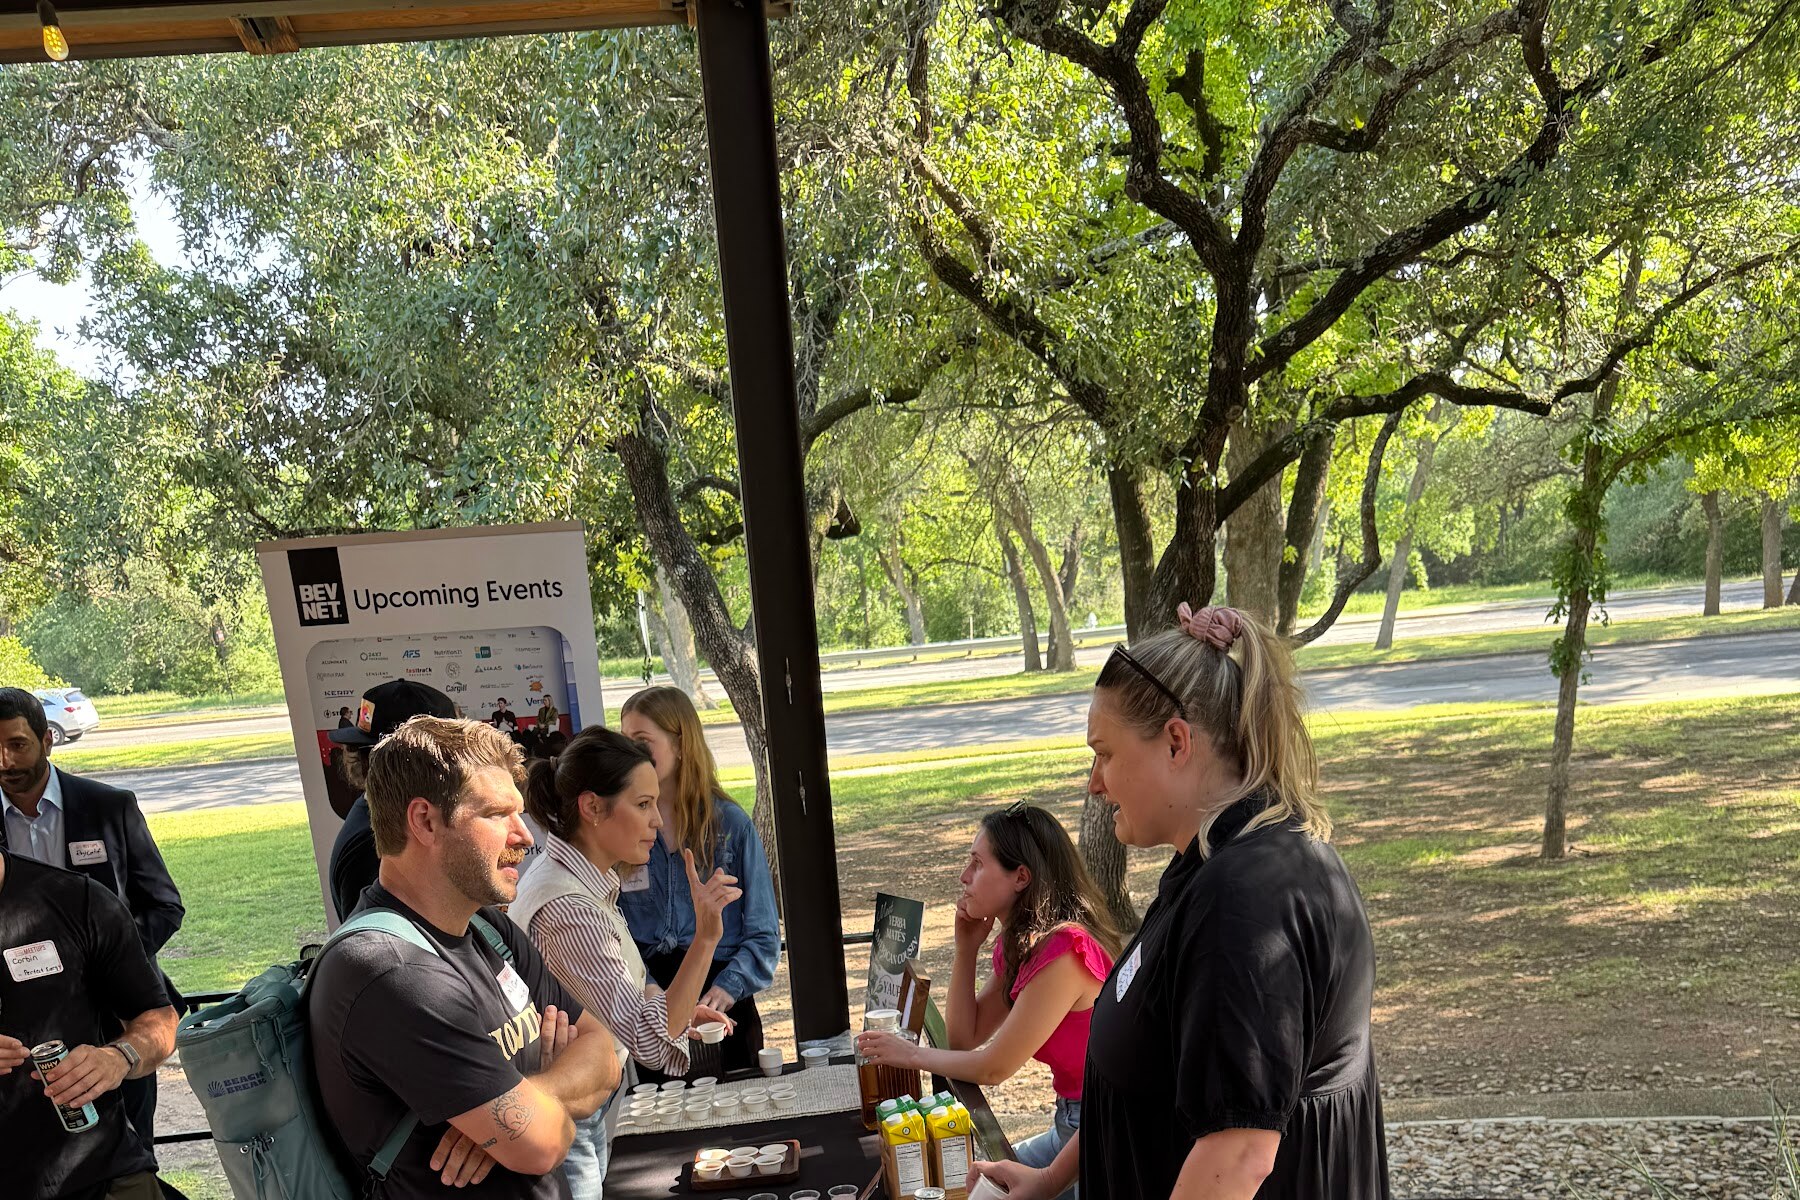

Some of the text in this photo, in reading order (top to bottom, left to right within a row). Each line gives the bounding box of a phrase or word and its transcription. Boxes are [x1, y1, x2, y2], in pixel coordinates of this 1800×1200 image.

[299, 583, 338, 602] BEV
[353, 579, 564, 615] Upcoming Events
[303, 601, 342, 620] NET
[402, 649, 421, 659] AFS
[446, 682, 468, 694] Cargill
[889, 915, 906, 929] YERBA
[12, 956, 38, 965] Corbin
[39, 1061, 58, 1070] WHY
[223, 1071, 264, 1087] BEACH
